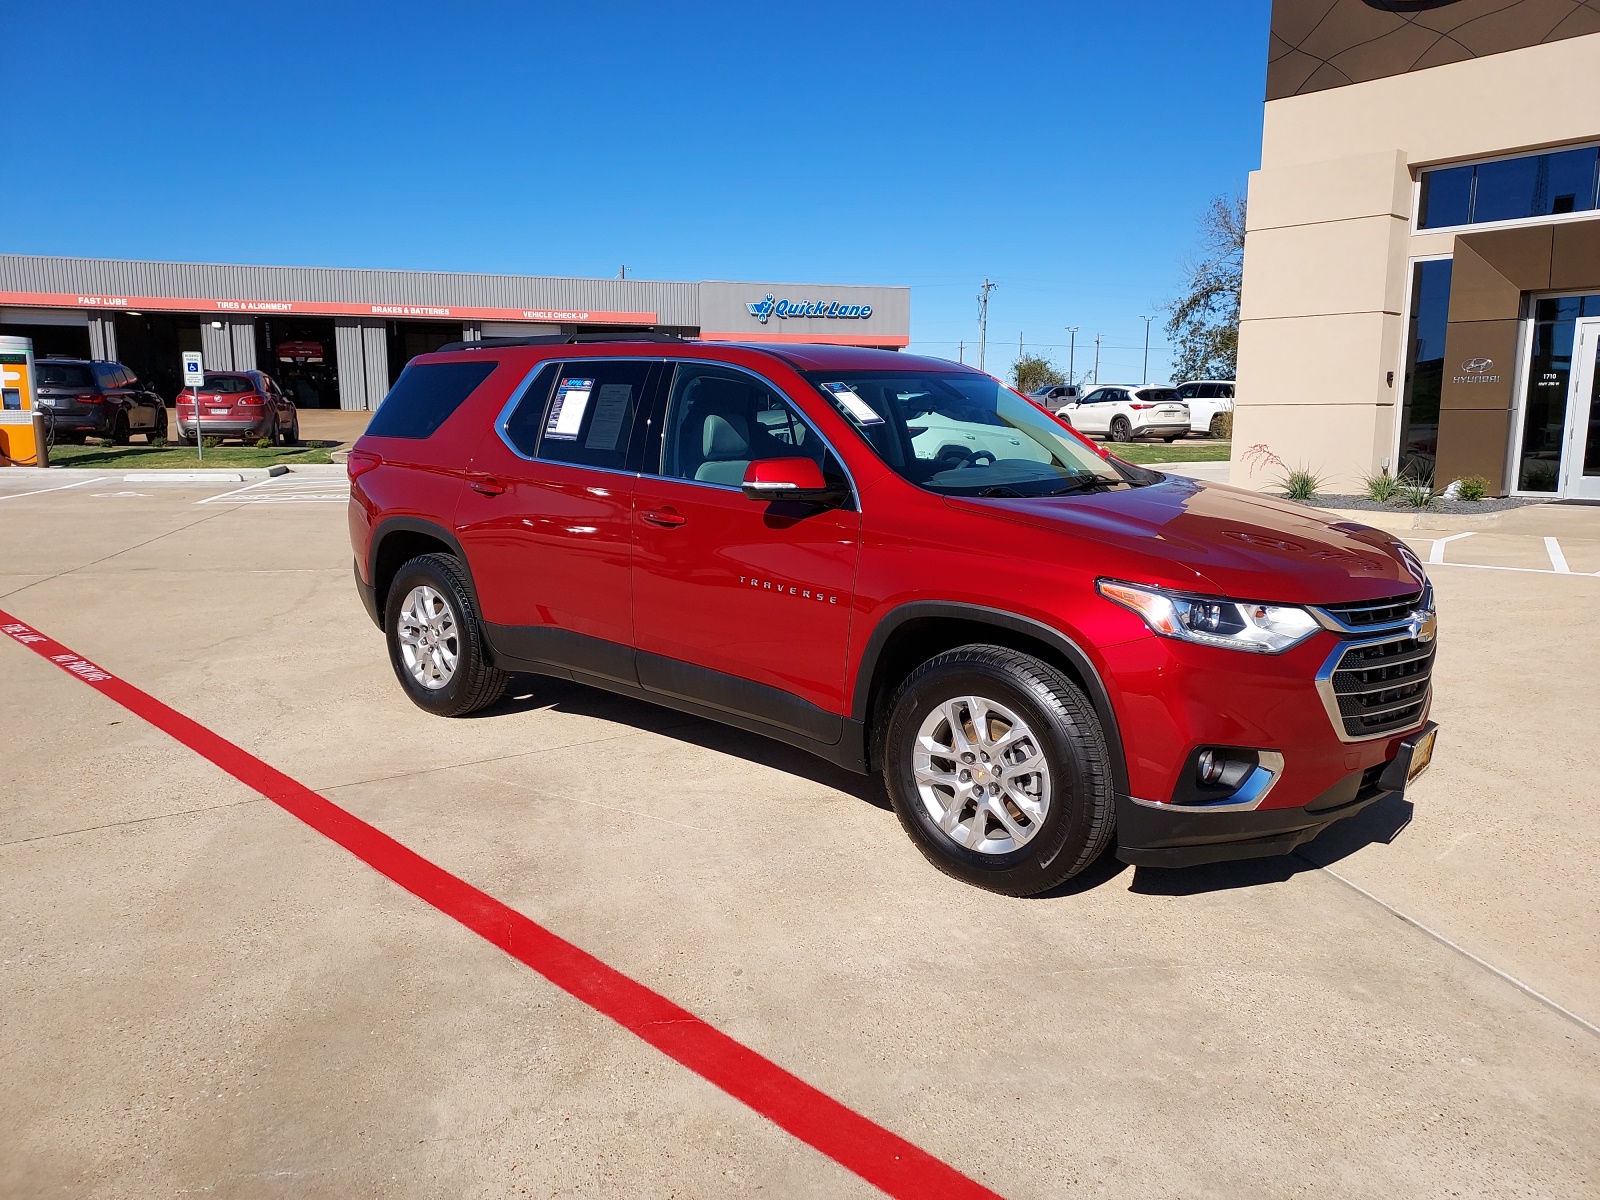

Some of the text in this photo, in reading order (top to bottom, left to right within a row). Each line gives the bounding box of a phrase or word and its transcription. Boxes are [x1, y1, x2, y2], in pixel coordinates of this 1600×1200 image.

[775, 298, 872, 317] Quick Lane
[1452, 376, 1500, 384] HYUNDAI
[740, 576, 837, 604] TRAVERSE
